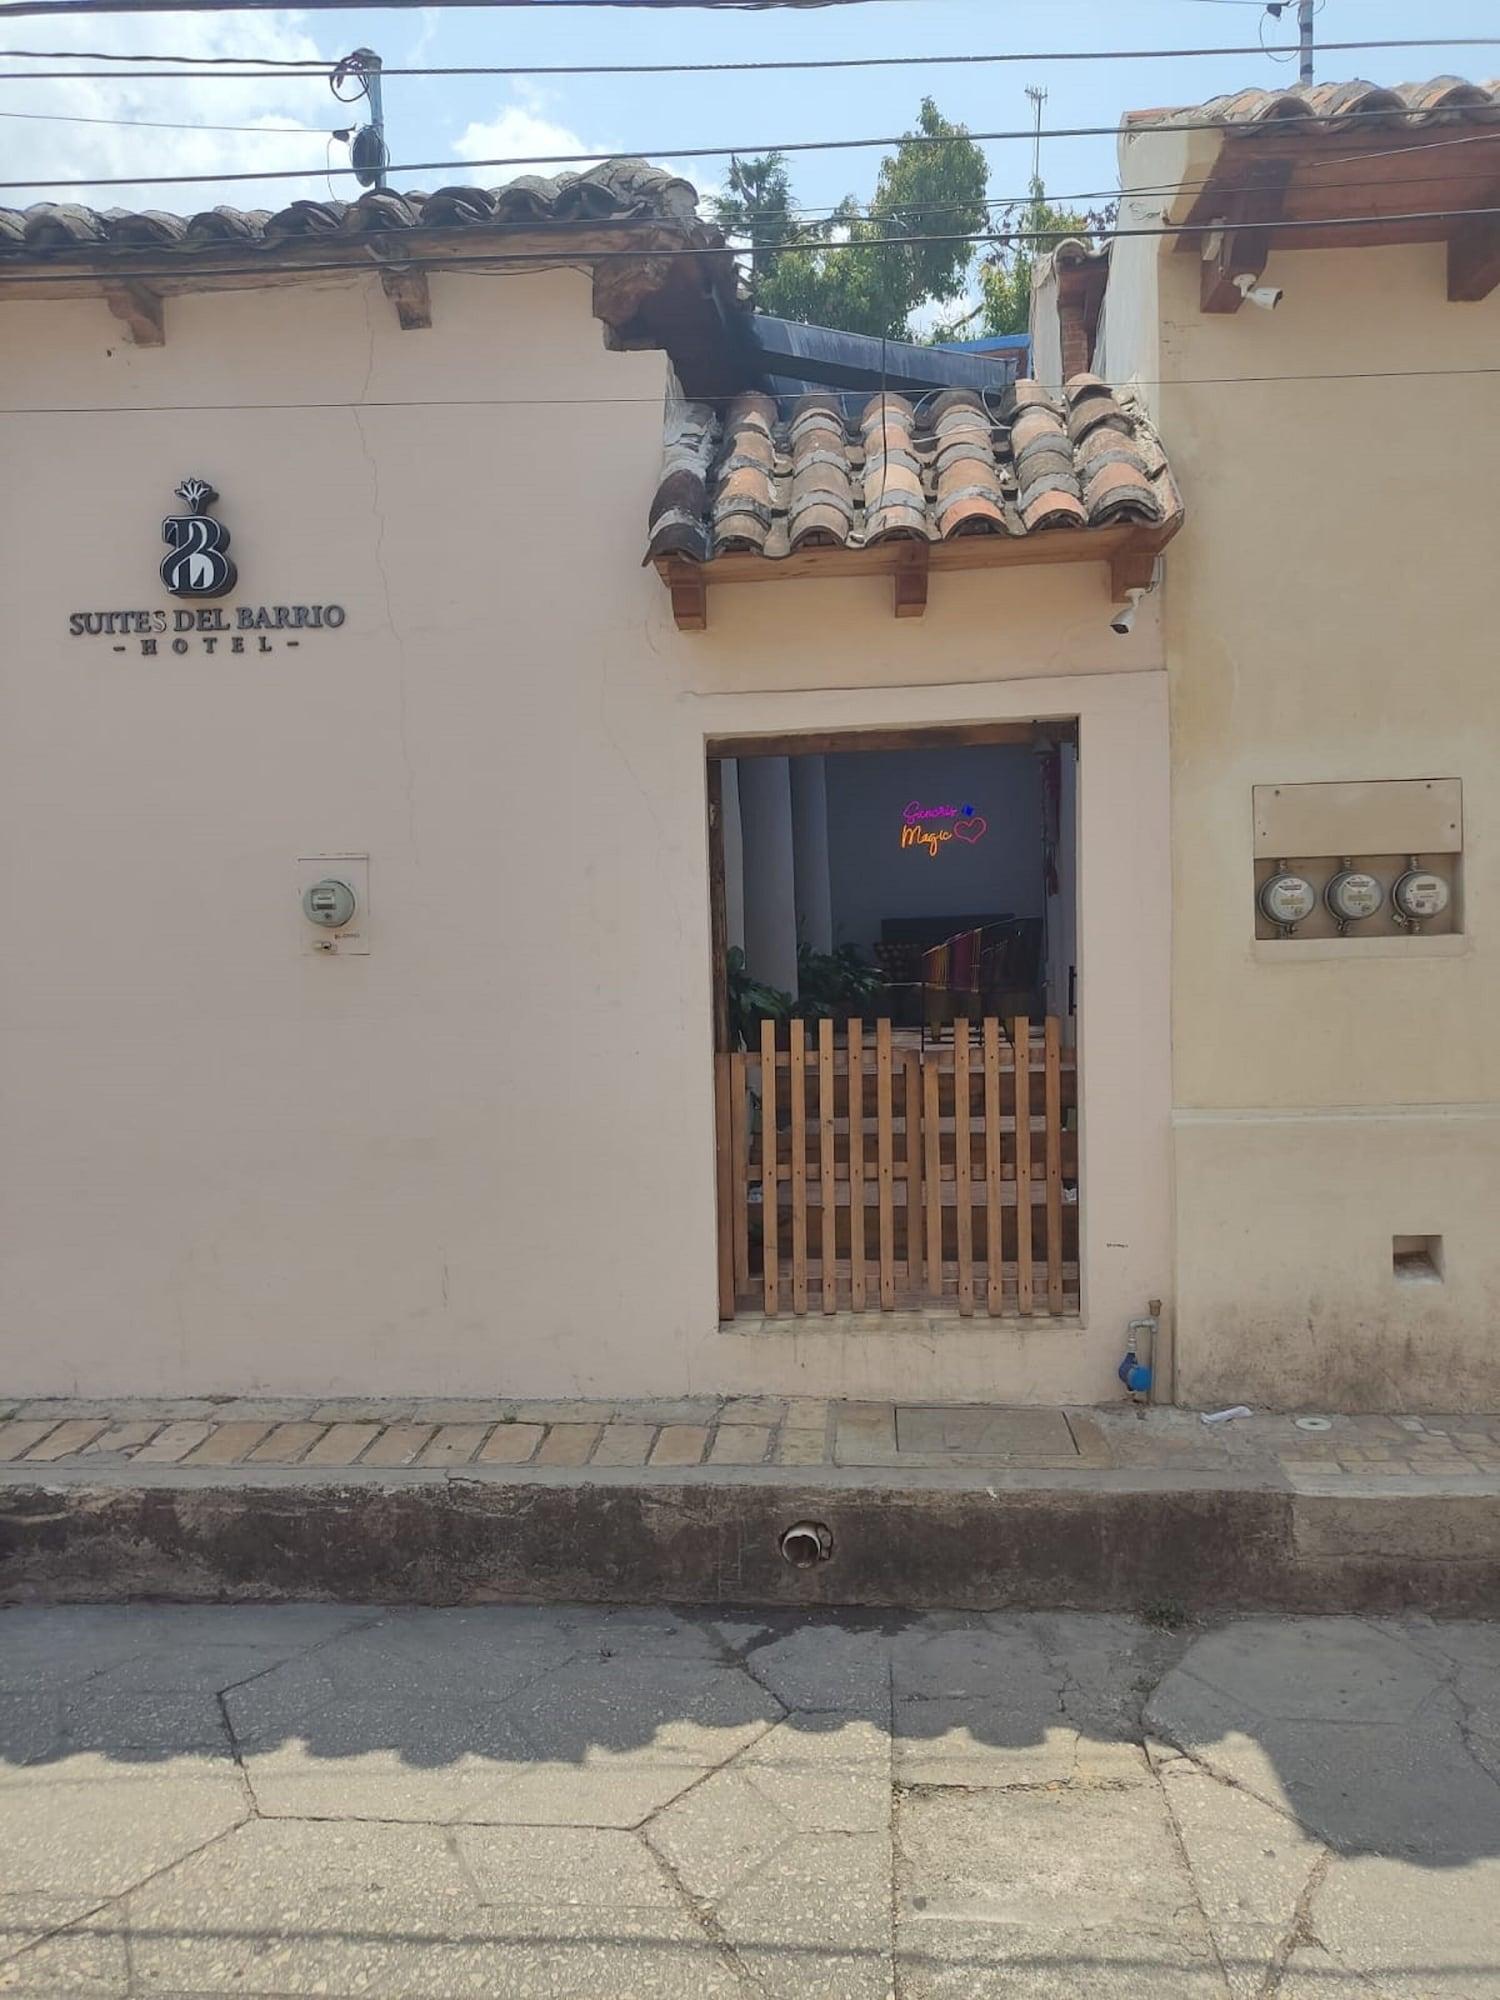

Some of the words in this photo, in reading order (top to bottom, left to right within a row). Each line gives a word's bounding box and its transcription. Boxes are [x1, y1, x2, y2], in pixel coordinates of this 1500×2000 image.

[69, 610, 167, 636] SUITES
[173, 608, 231, 632] DEL
[236, 604, 345, 630] BARRIO
[901, 824, 953, 857] Magic
